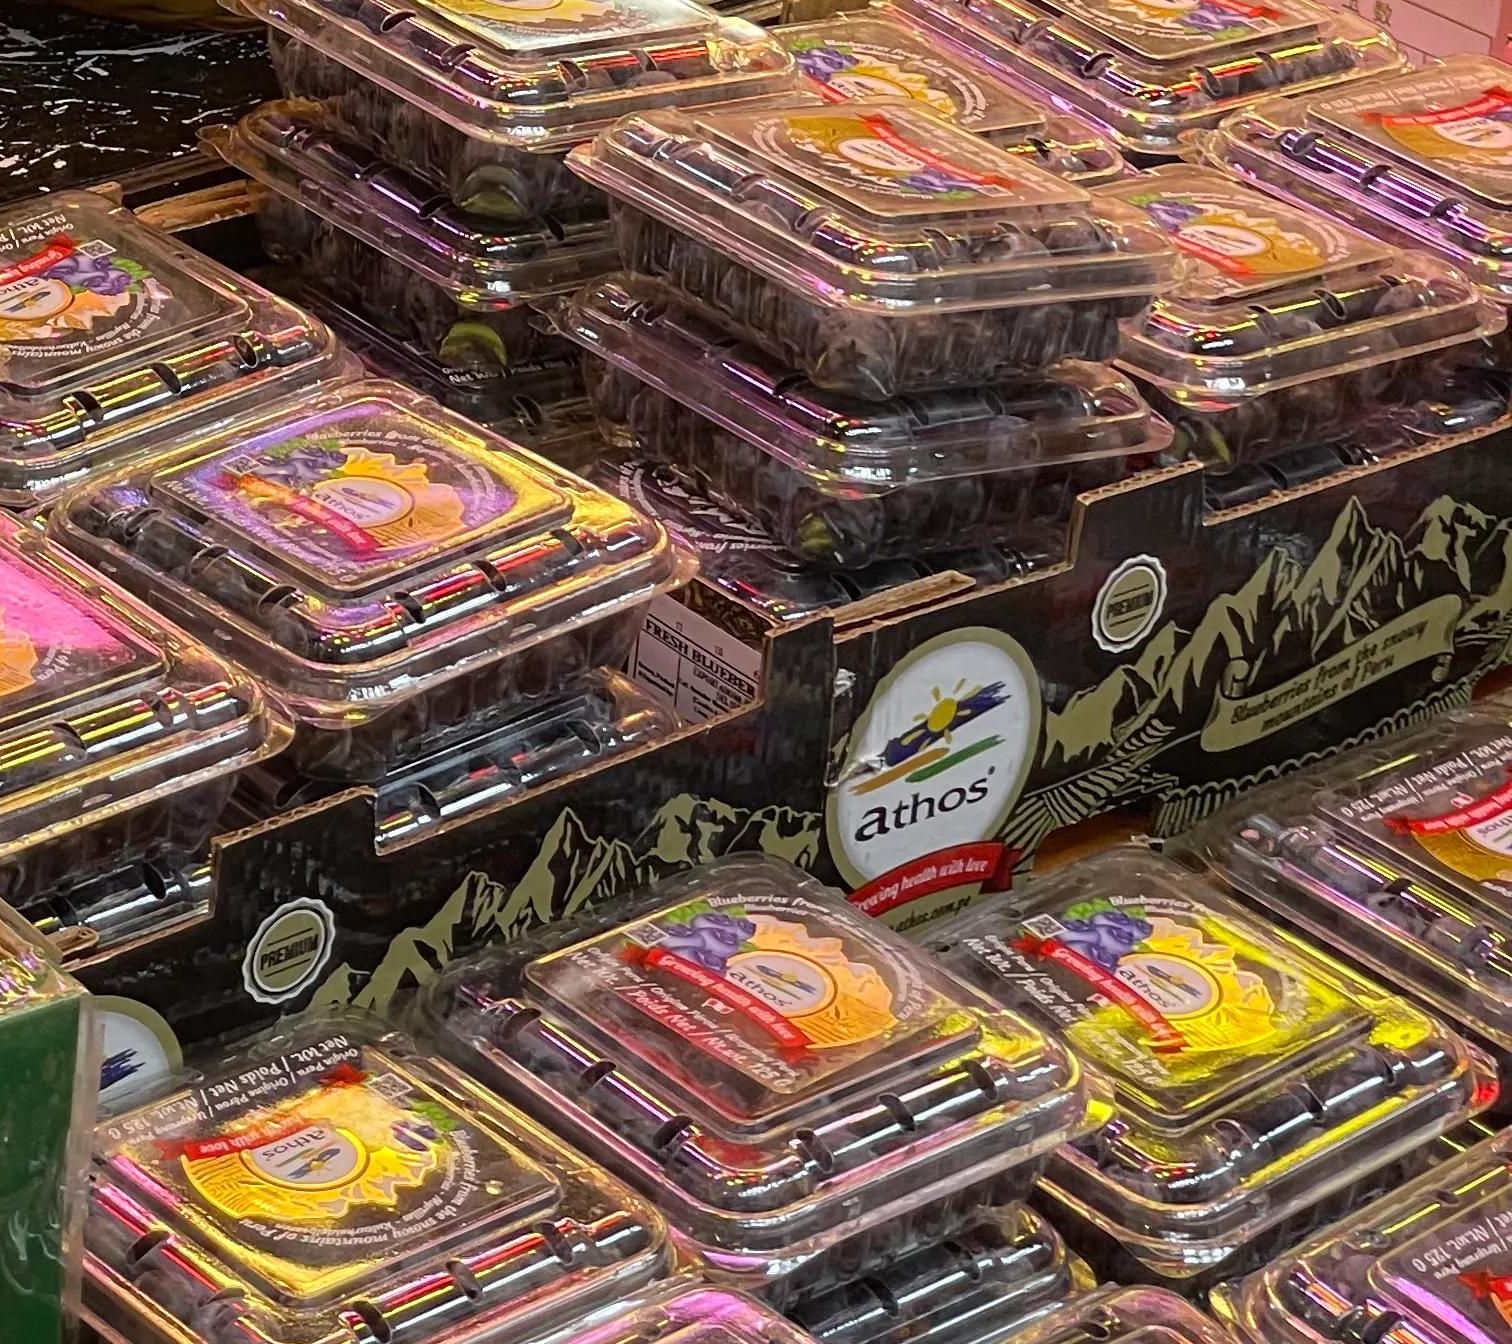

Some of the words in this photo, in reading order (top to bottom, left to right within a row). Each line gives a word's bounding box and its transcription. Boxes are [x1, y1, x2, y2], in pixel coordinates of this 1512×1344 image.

[44, 214, 68, 229] Net
[645, 618, 690, 656] FRESH
[854, 778, 989, 842] athos
[707, 893, 789, 909] Blueberries
[729, 971, 788, 1009] athos
[1118, 968, 1172, 1010] athos
[324, 1034, 349, 1051] Net
[238, 1062, 283, 1086] Poids
[208, 1078, 239, 1099] Net
[122, 1114, 152, 1135] 125
[199, 1139, 229, 1155] love
[263, 1128, 326, 1160] athos
[300, 1232, 389, 1248] mountains
